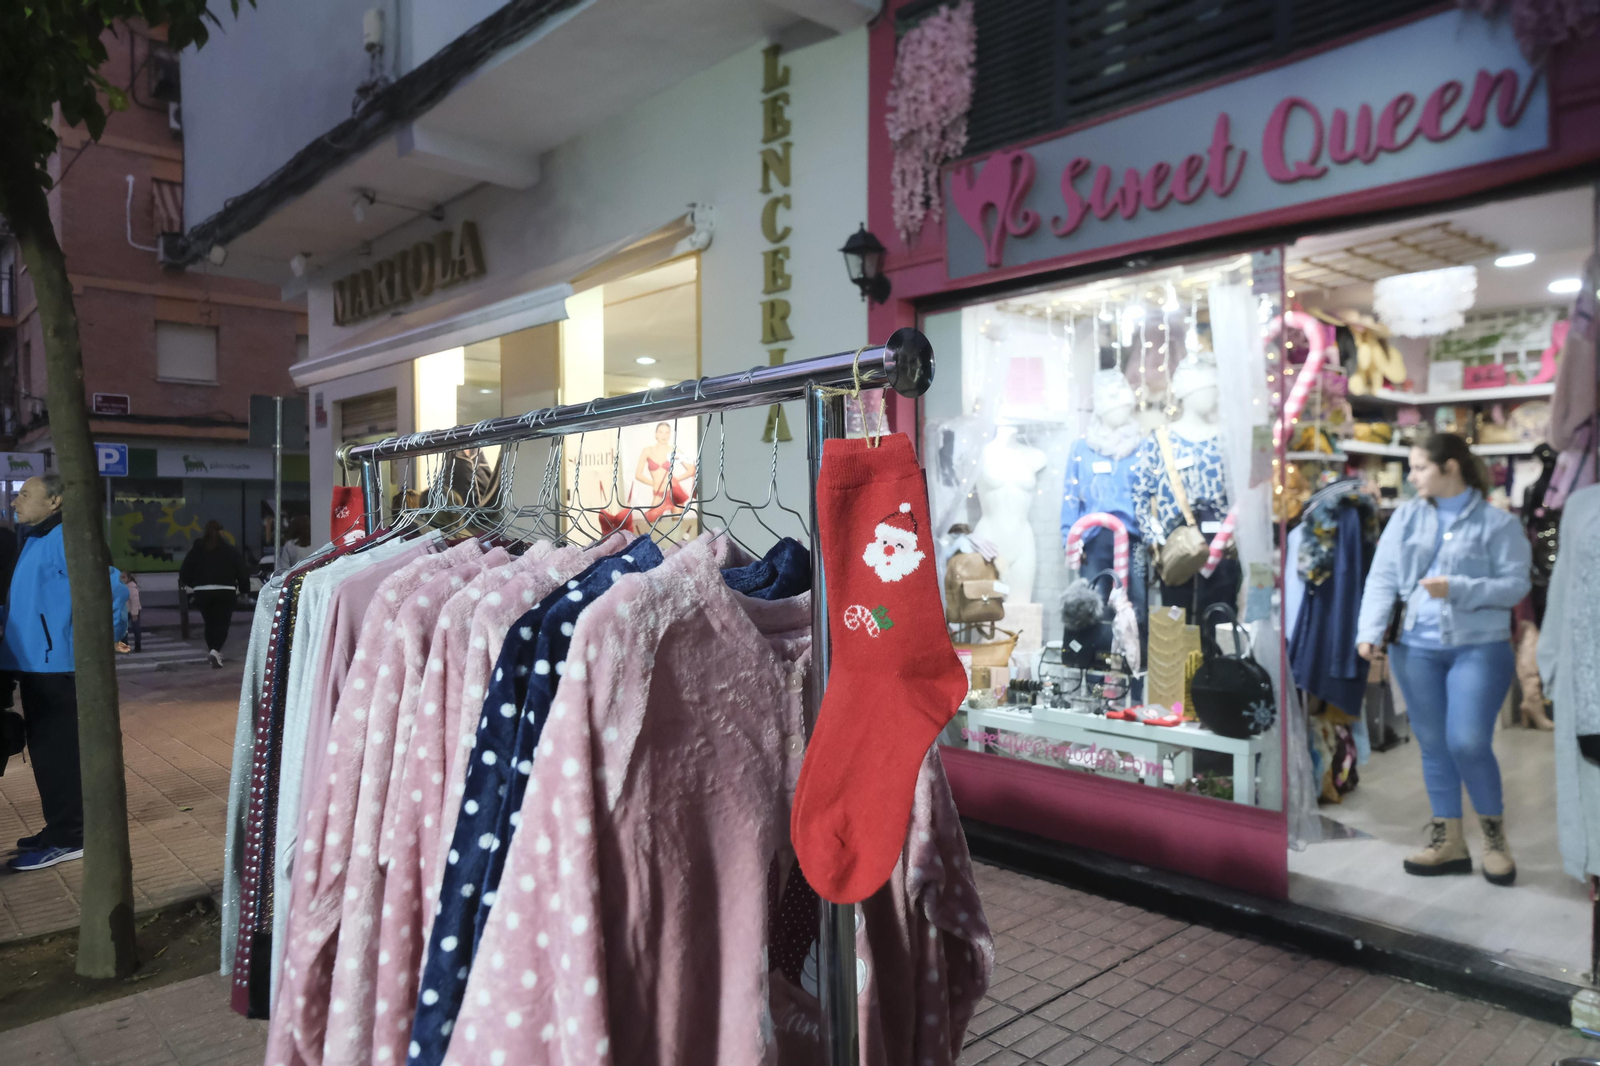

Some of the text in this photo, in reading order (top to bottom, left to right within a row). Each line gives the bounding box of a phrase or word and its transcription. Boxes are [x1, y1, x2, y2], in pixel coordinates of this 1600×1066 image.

[1050, 66, 1537, 238] Sweet Queen
[332, 220, 487, 327] MARIOLA
[98, 448, 120, 471] P
